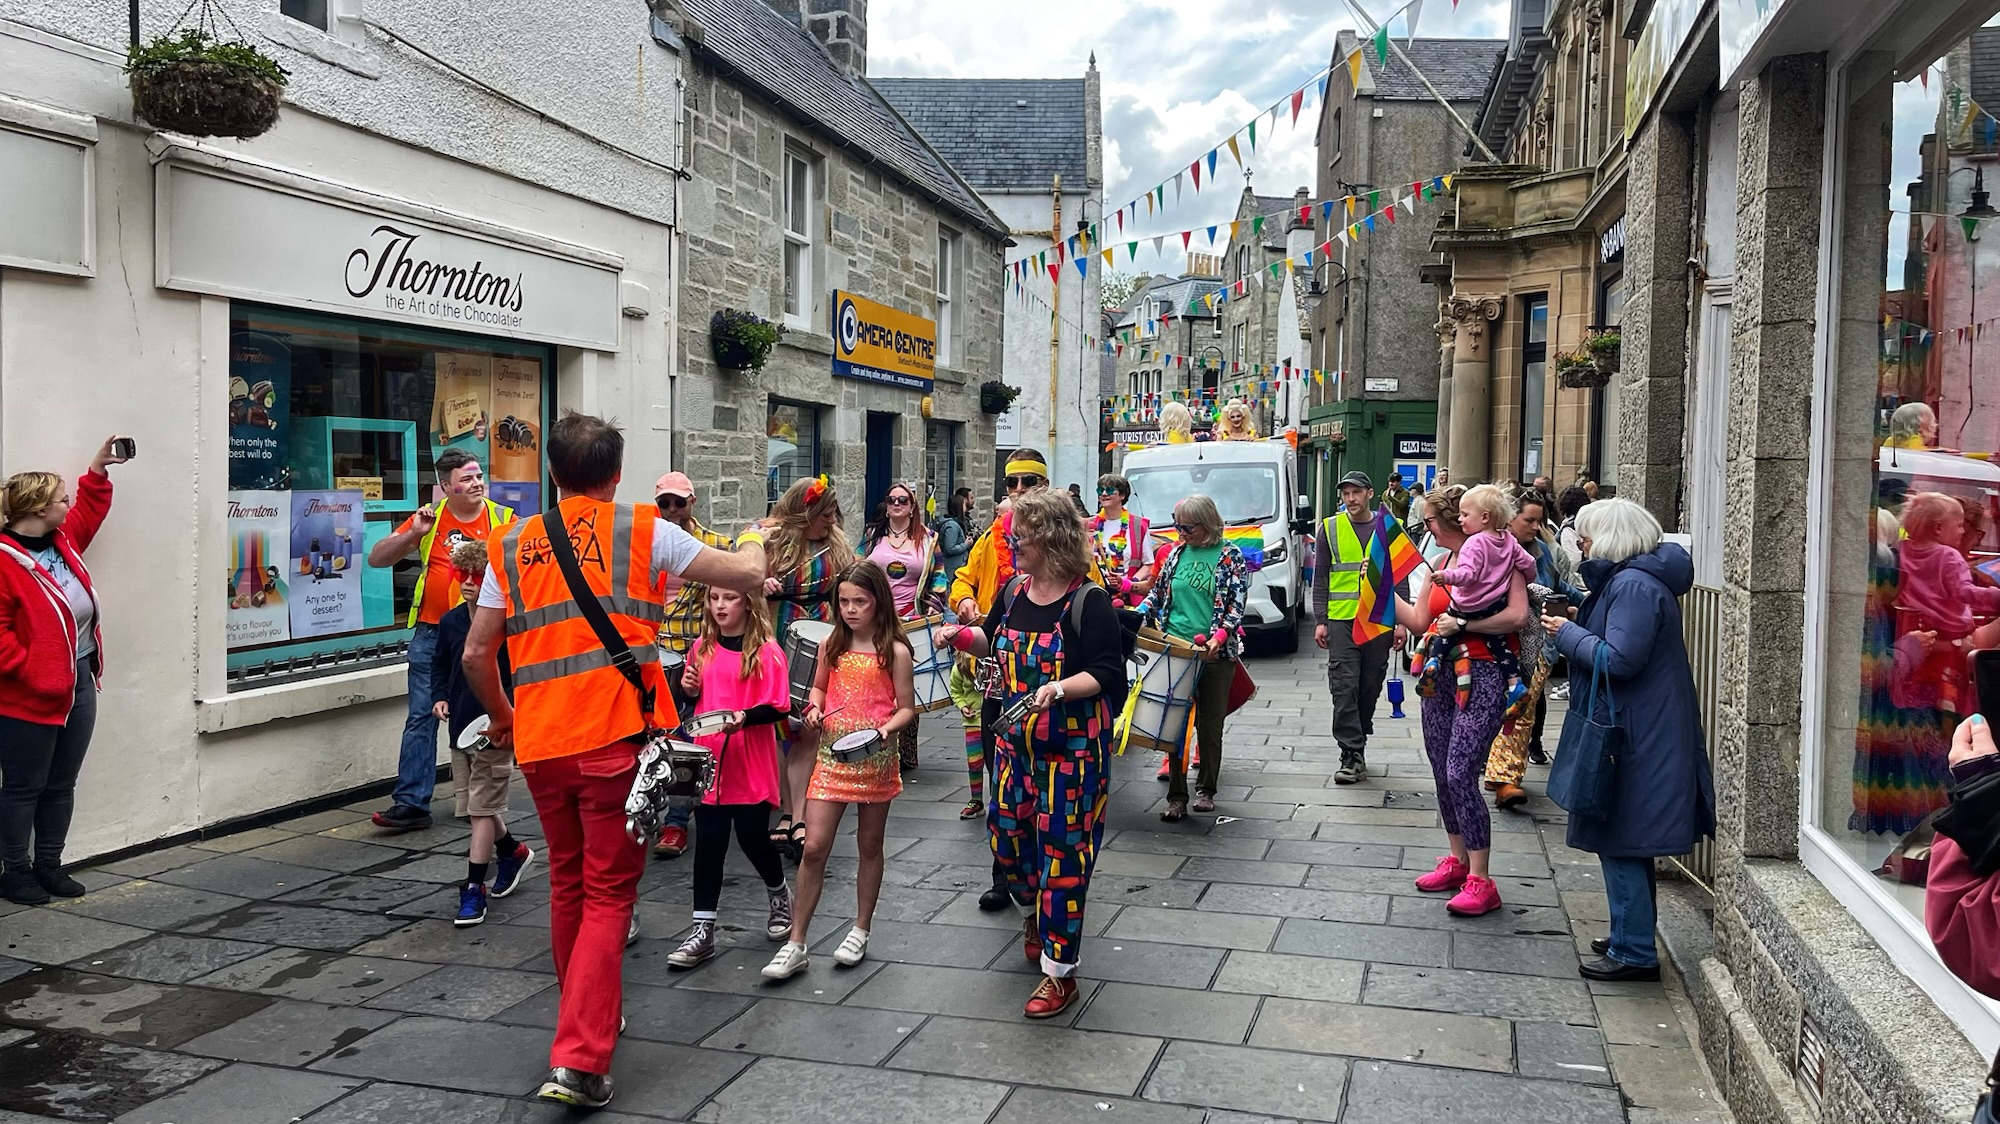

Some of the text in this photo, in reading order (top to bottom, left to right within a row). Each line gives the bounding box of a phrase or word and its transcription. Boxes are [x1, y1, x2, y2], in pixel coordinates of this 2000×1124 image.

[345, 225, 523, 312] Thorntons
[386, 294, 523, 328] the Art of the Chocolatier
[839, 298, 934, 360] CAMERA CENTRE
[229, 436, 278, 449] hen only the
[1113, 431, 1144, 442] TOURIST
[1401, 441, 1418, 451] HM
[247, 449, 261, 459] will
[261, 449, 273, 459] do
[227, 501, 279, 519] Thorntons
[304, 498, 353, 518] Thorntons
[305, 591, 347, 605] Any one for
[311, 602, 343, 616] dessert?
[269, 628, 282, 638] you
